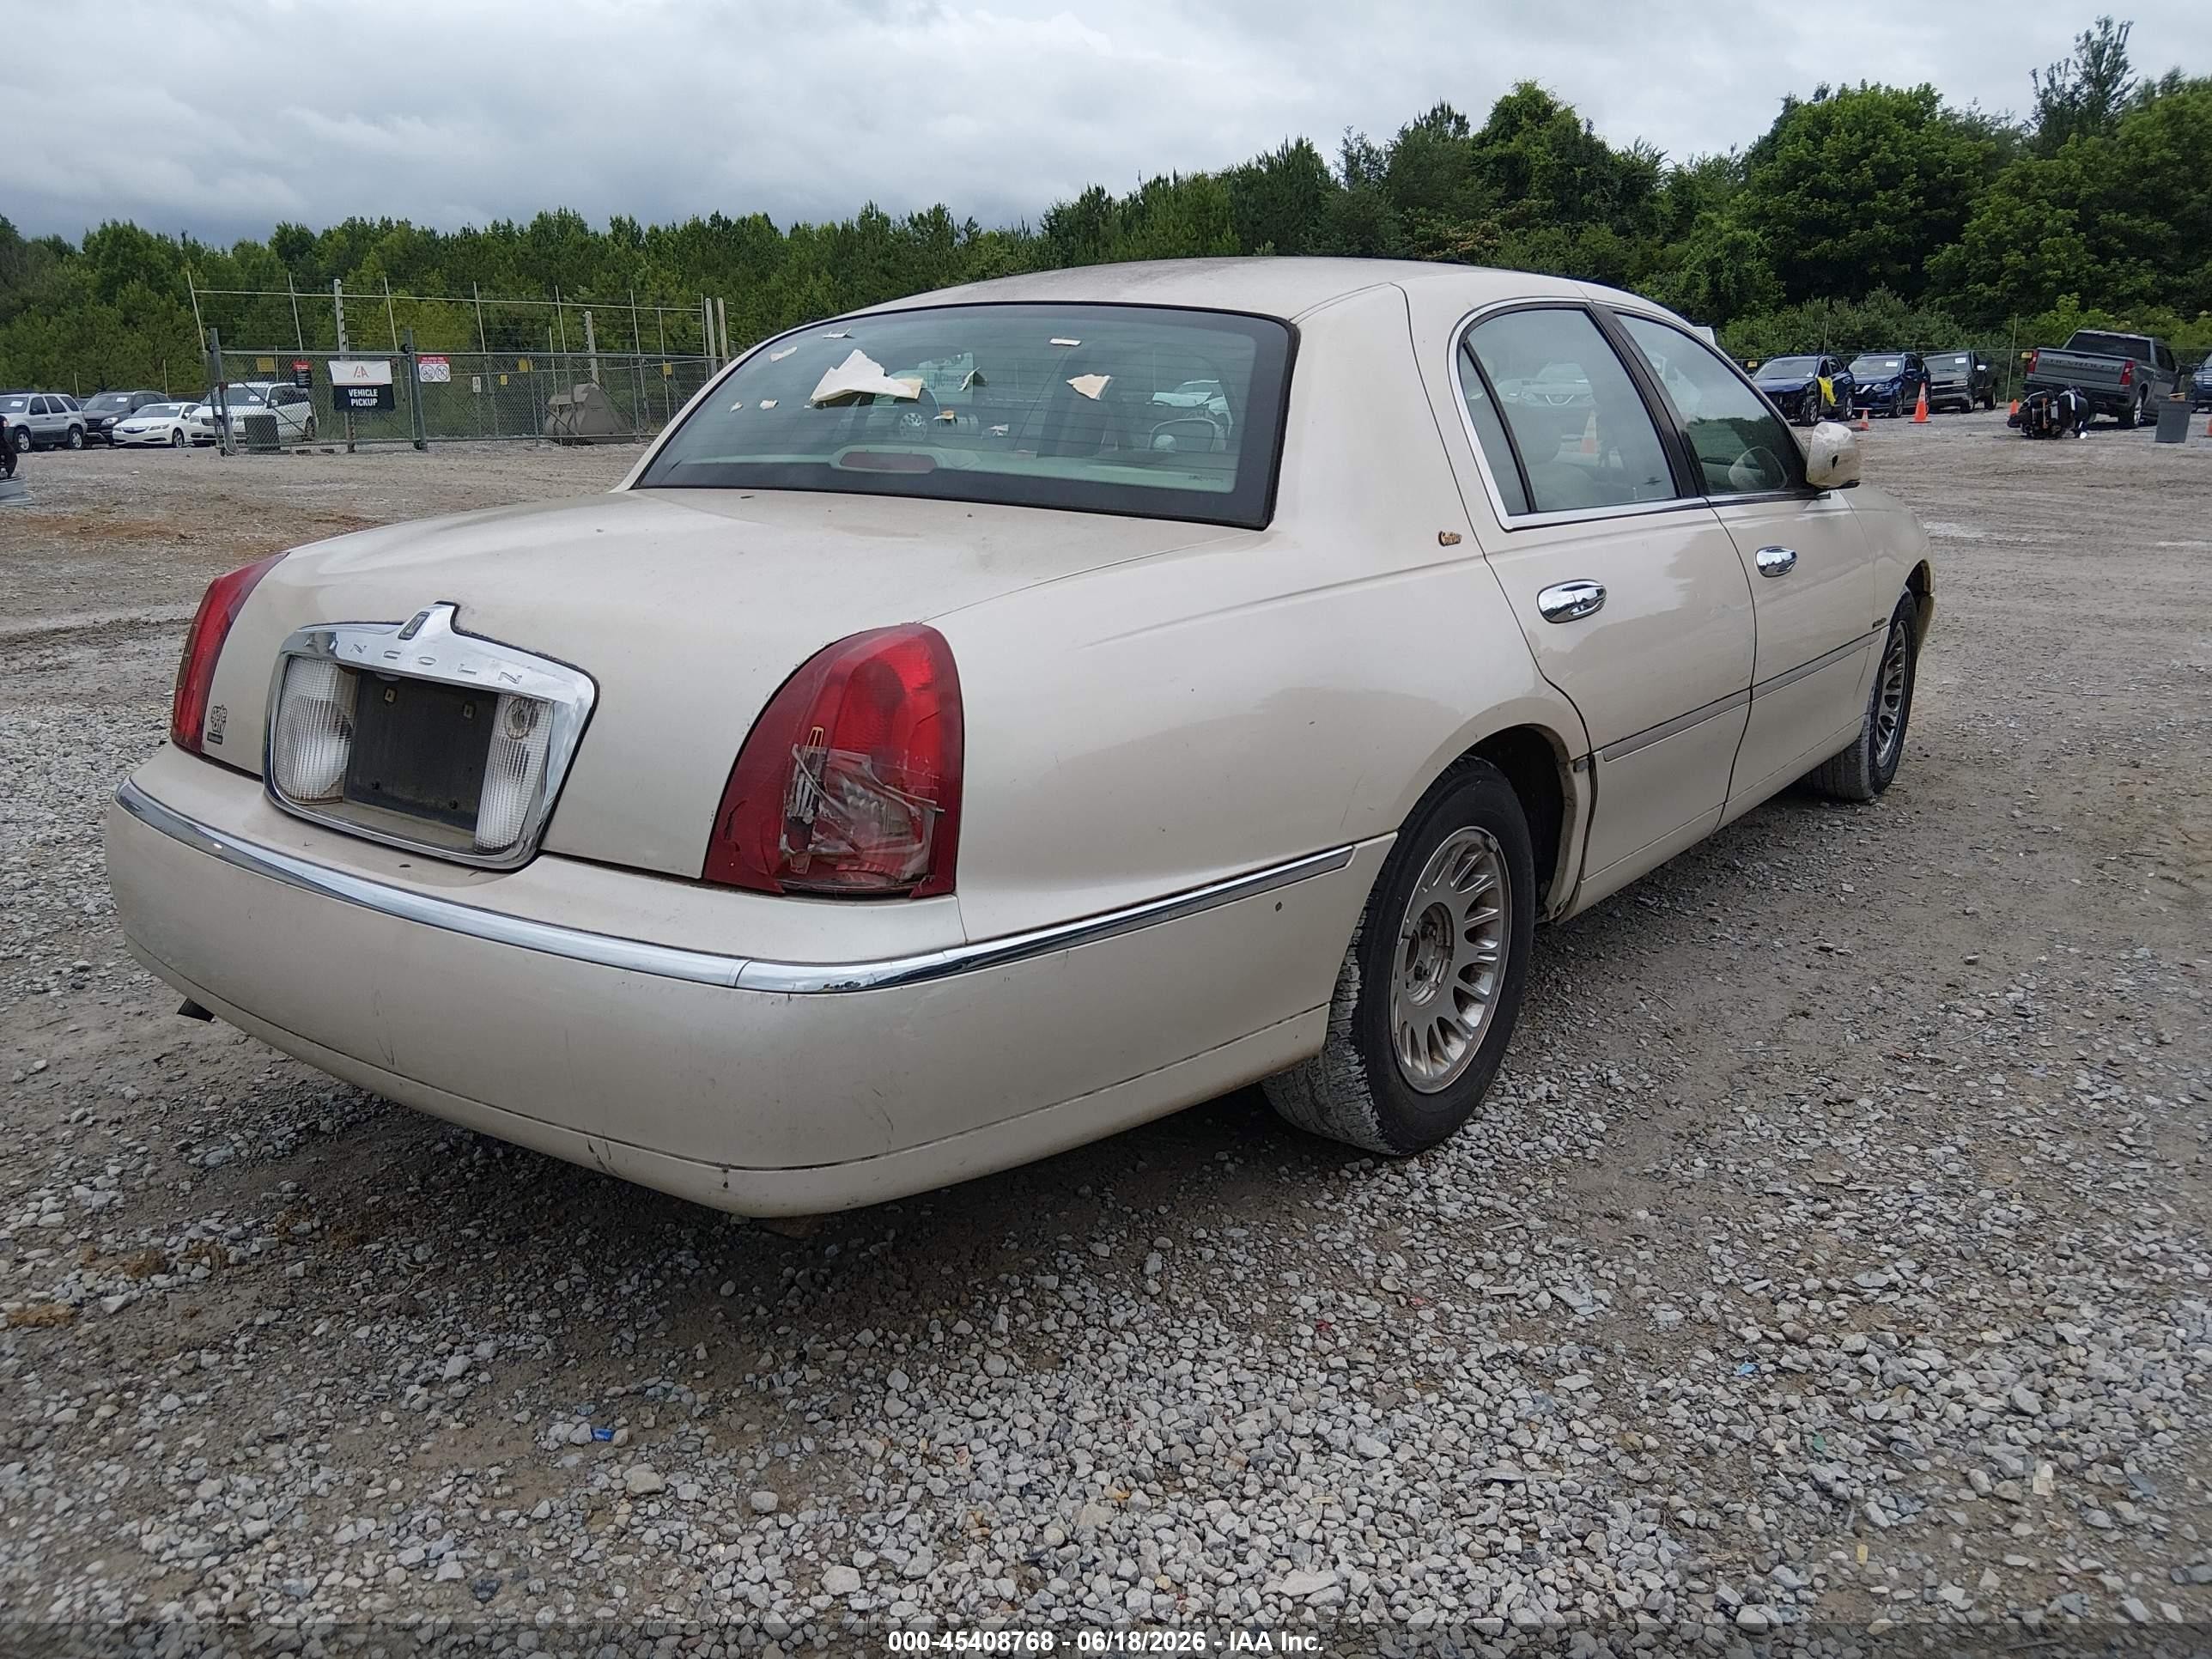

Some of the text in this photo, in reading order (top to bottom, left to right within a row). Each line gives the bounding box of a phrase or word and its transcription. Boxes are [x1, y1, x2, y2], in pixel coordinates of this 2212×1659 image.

[348, 388, 379, 398] VEHICLE
[350, 398, 378, 407] PICKUP
[303, 636, 523, 685] LINCOLN
